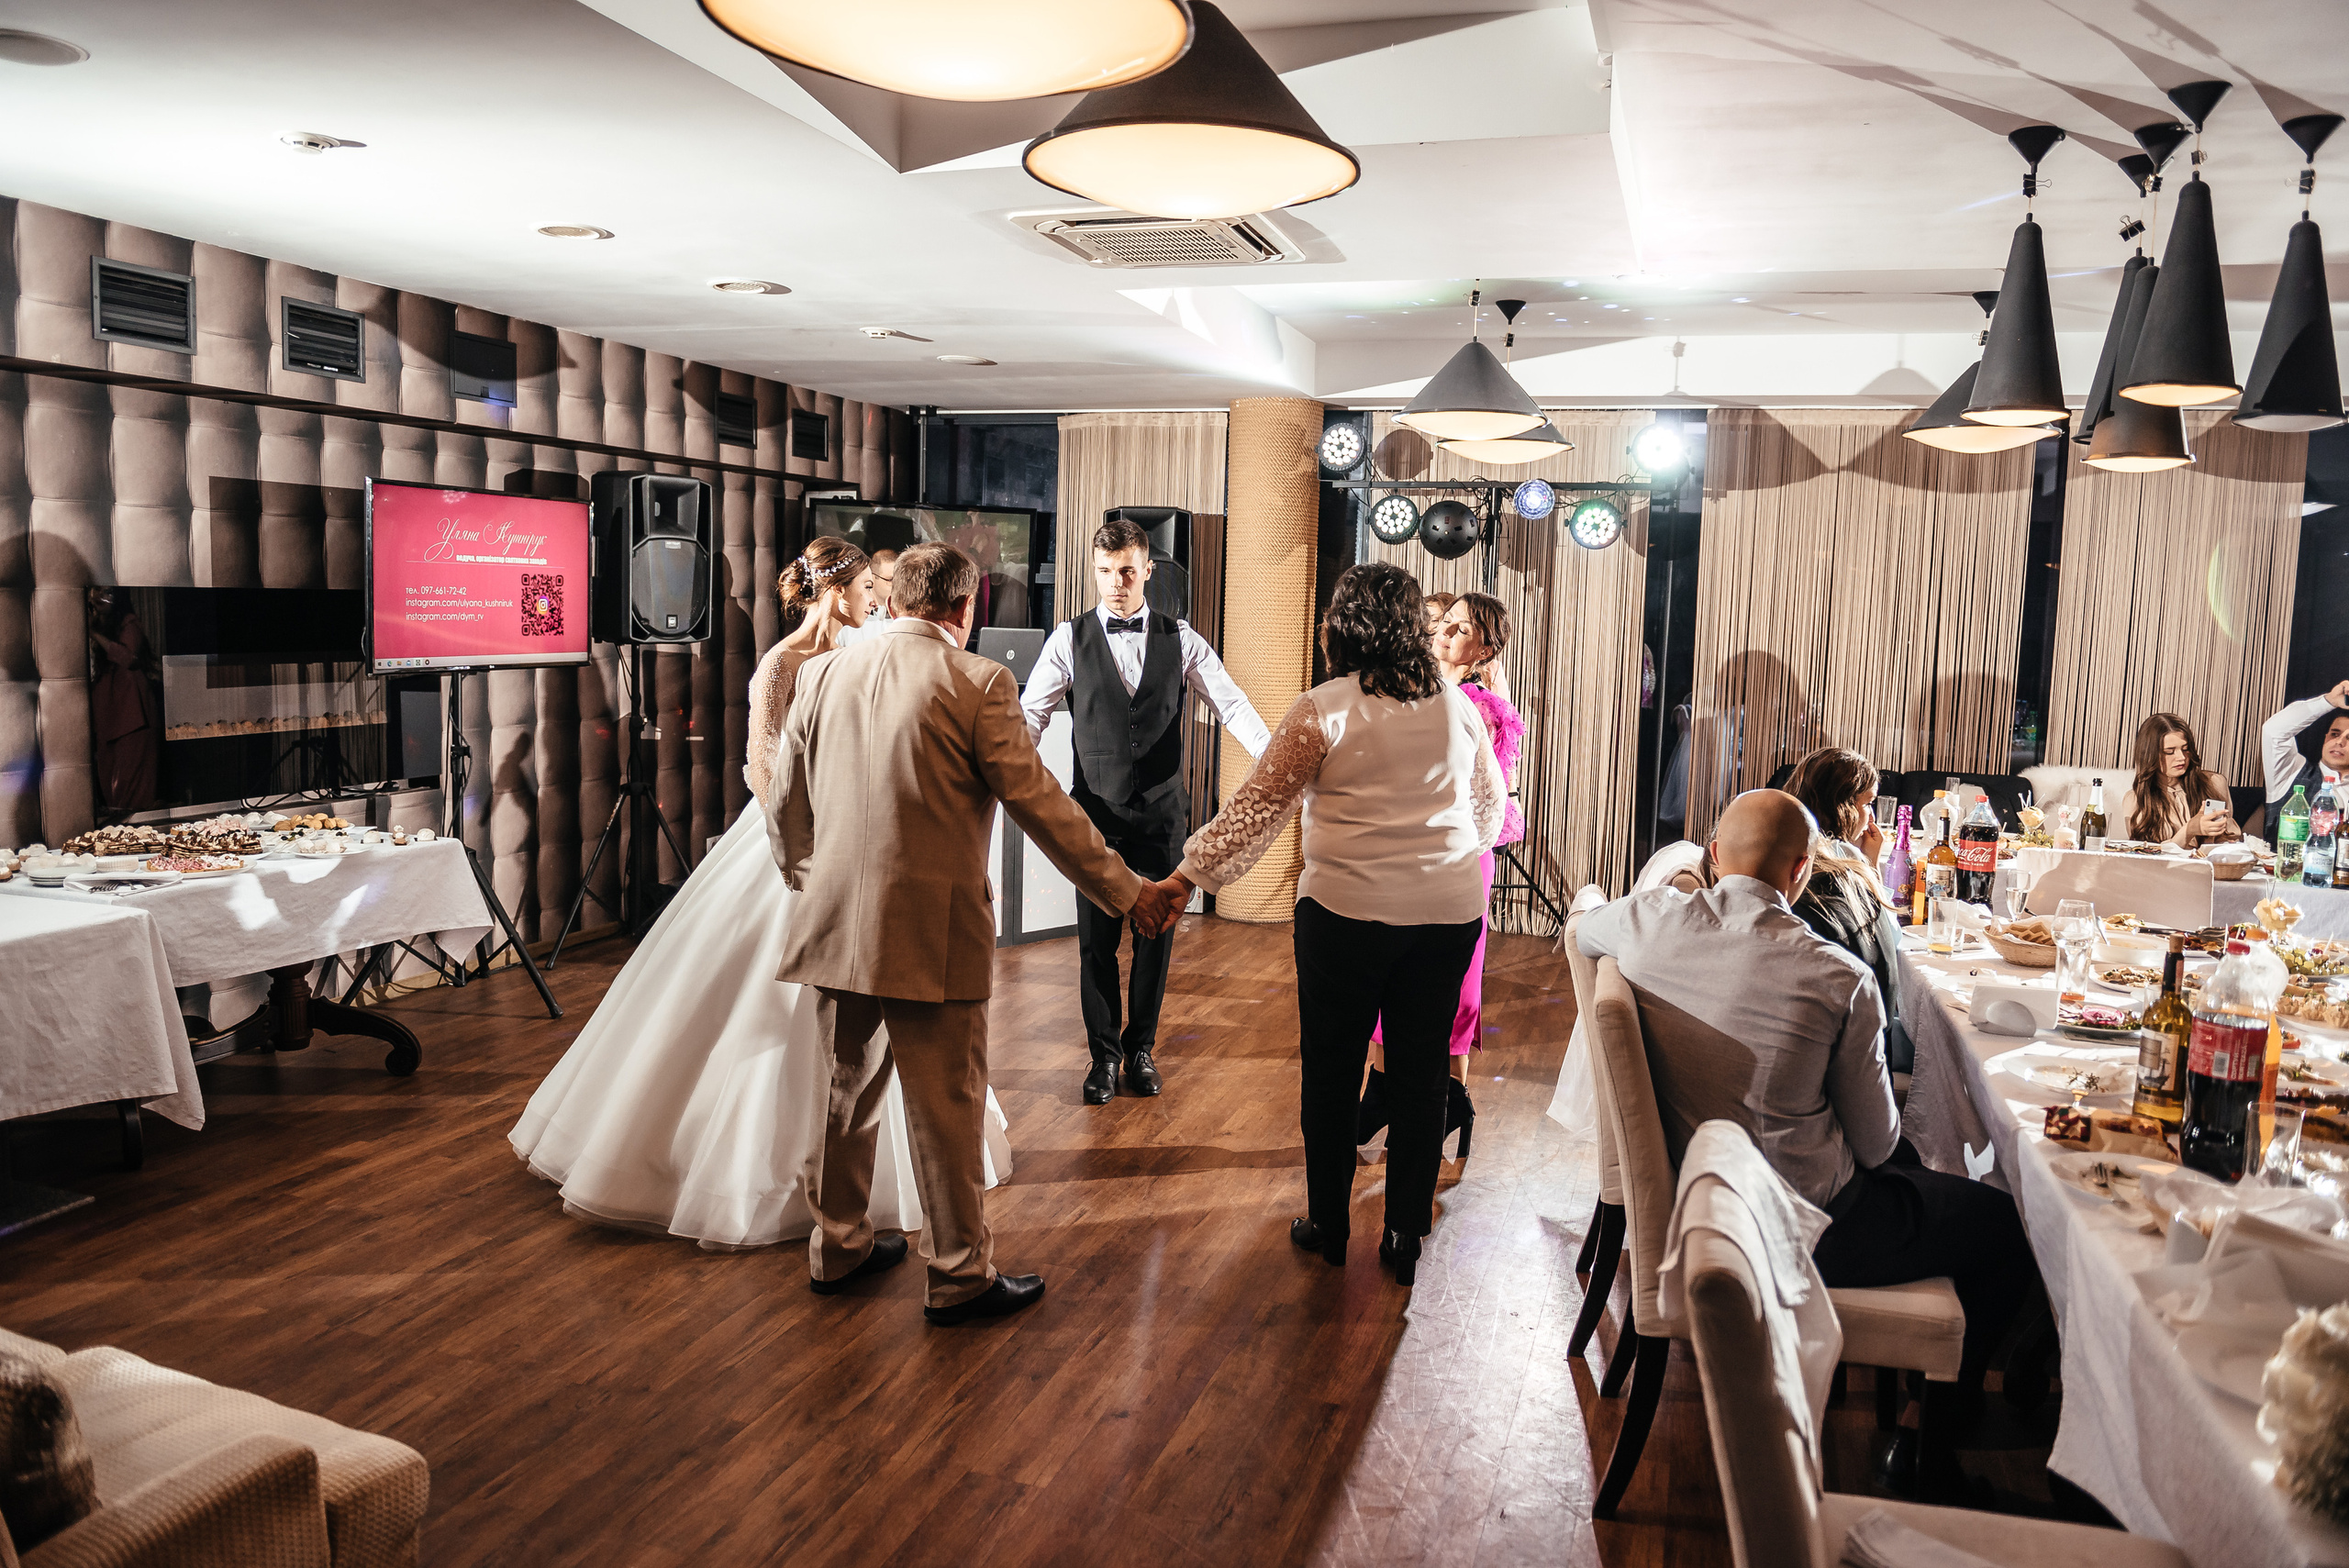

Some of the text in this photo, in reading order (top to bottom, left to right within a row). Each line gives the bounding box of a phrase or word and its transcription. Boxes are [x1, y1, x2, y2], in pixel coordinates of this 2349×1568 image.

[424, 517, 548, 562] Уляна Кушнірук
[420, 586, 467, 595] 097-661-72-42
[406, 597, 514, 609] instagram.com/ulyana_kushniruk
[406, 611, 484, 623] instagram.com/dym_rv
